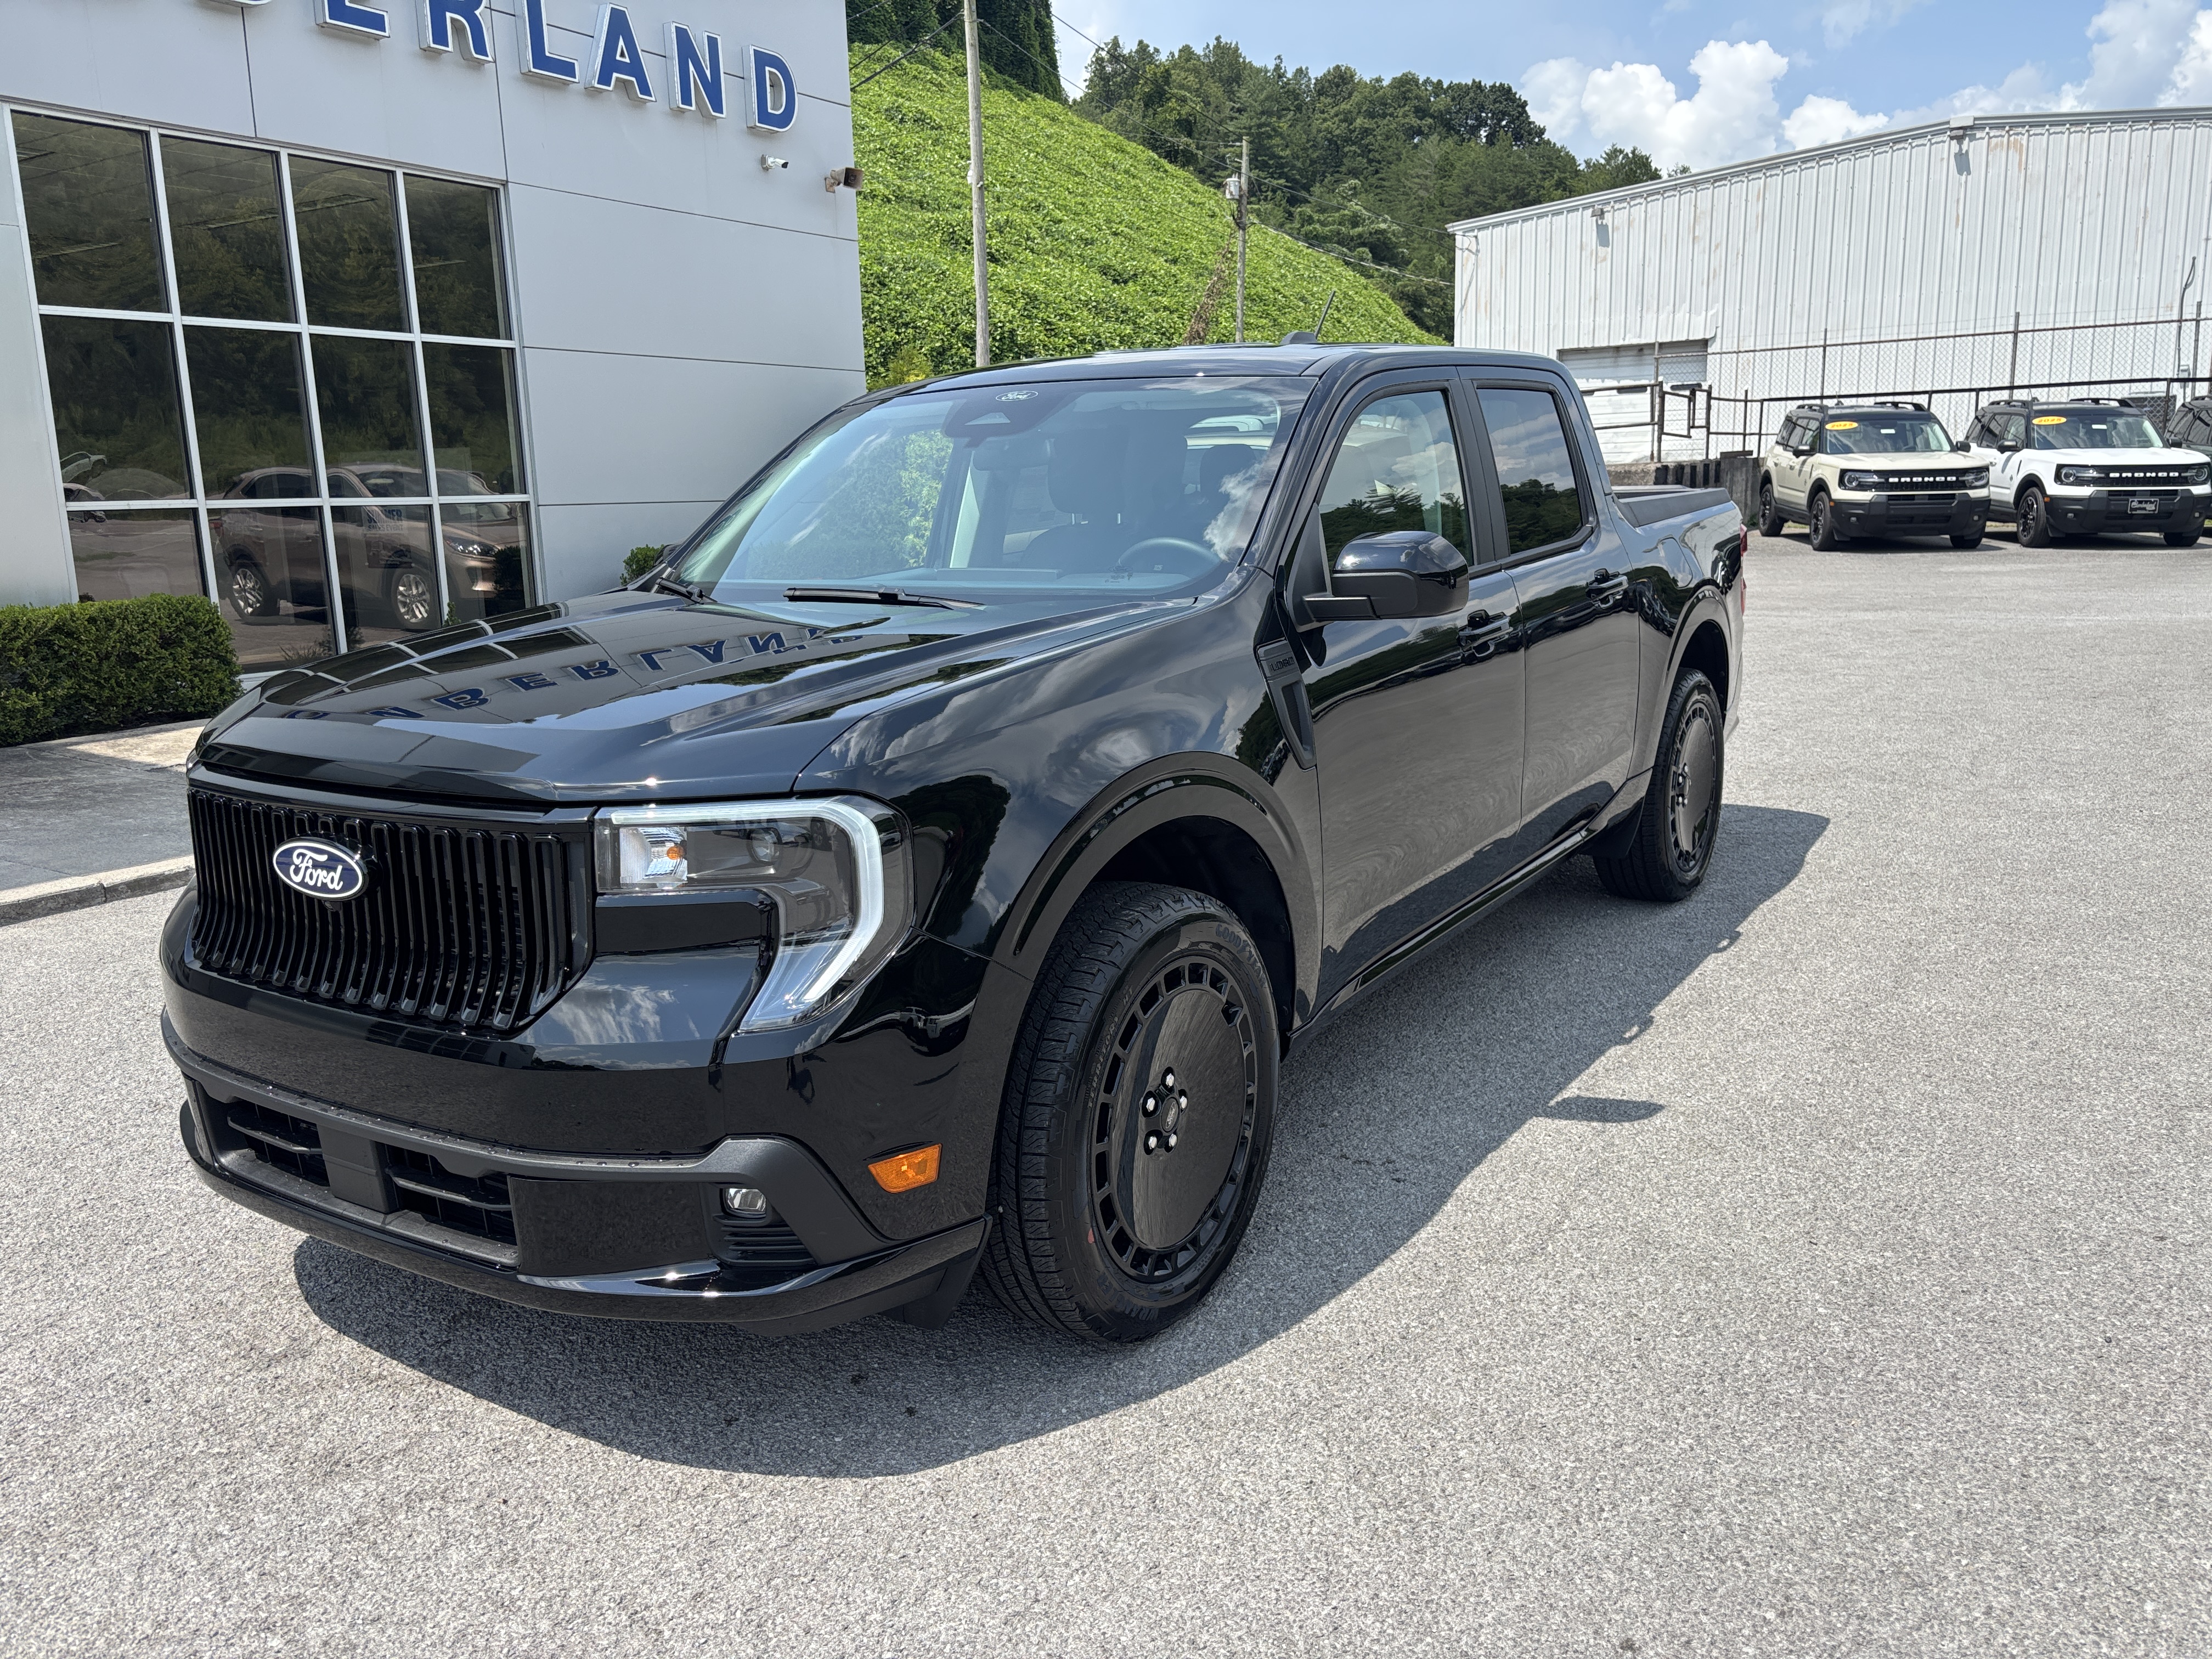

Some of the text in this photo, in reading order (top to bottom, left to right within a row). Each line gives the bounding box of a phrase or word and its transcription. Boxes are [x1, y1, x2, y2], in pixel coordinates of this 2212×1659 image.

[202, 0, 798, 133] RLAND
[1001, 392, 1032, 400] Ford
[290, 848, 343, 890] Ford
[1215, 923, 1267, 989] GOODYEAR
